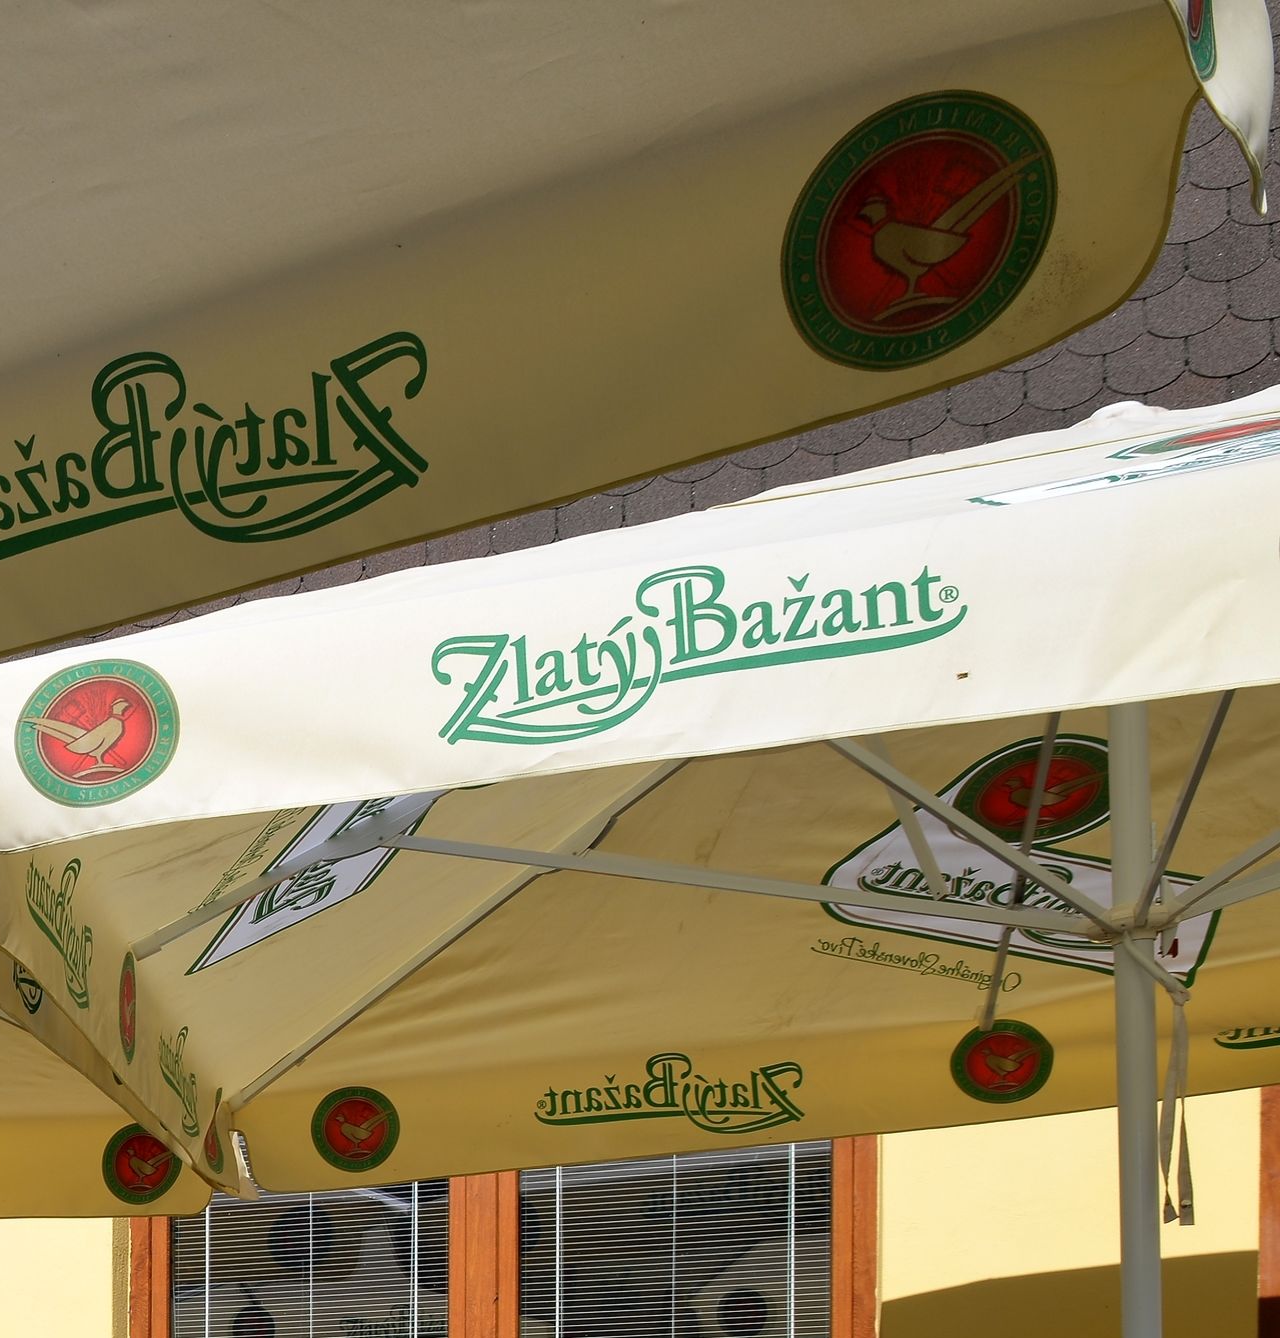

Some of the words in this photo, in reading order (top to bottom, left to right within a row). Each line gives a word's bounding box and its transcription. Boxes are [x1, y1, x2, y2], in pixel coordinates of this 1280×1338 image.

[432, 614, 663, 745] Zlatý
[636, 564, 943, 664] Bažant
[112, 665, 171, 718] QUALITY
[78, 775, 141, 801] SLOVAK
